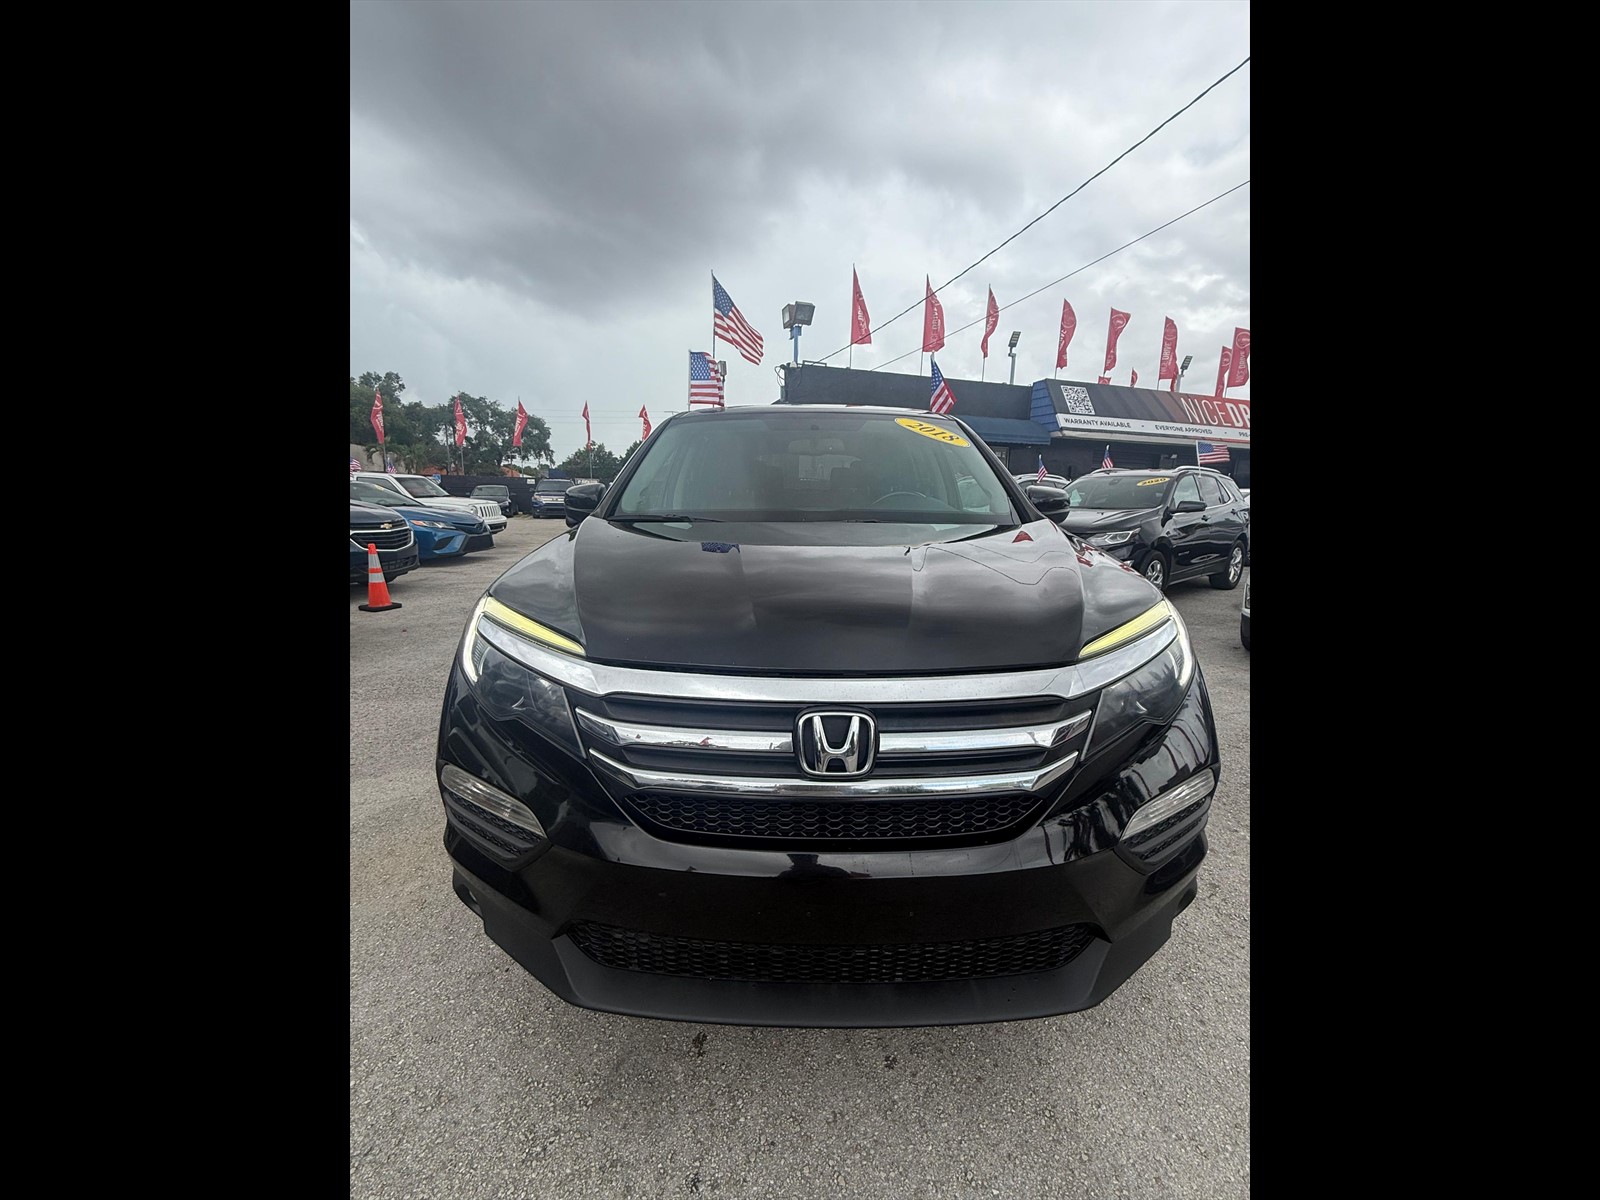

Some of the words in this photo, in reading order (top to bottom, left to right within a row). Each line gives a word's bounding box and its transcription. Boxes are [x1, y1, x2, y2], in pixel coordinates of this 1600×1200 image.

[905, 422, 960, 441] 2018
[1063, 417, 1098, 426] WARRANTY
[1100, 420, 1131, 428] AVAILABLE
[1155, 424, 1184, 433] EVERYONE
[1184, 427, 1213, 435] APPROVED
